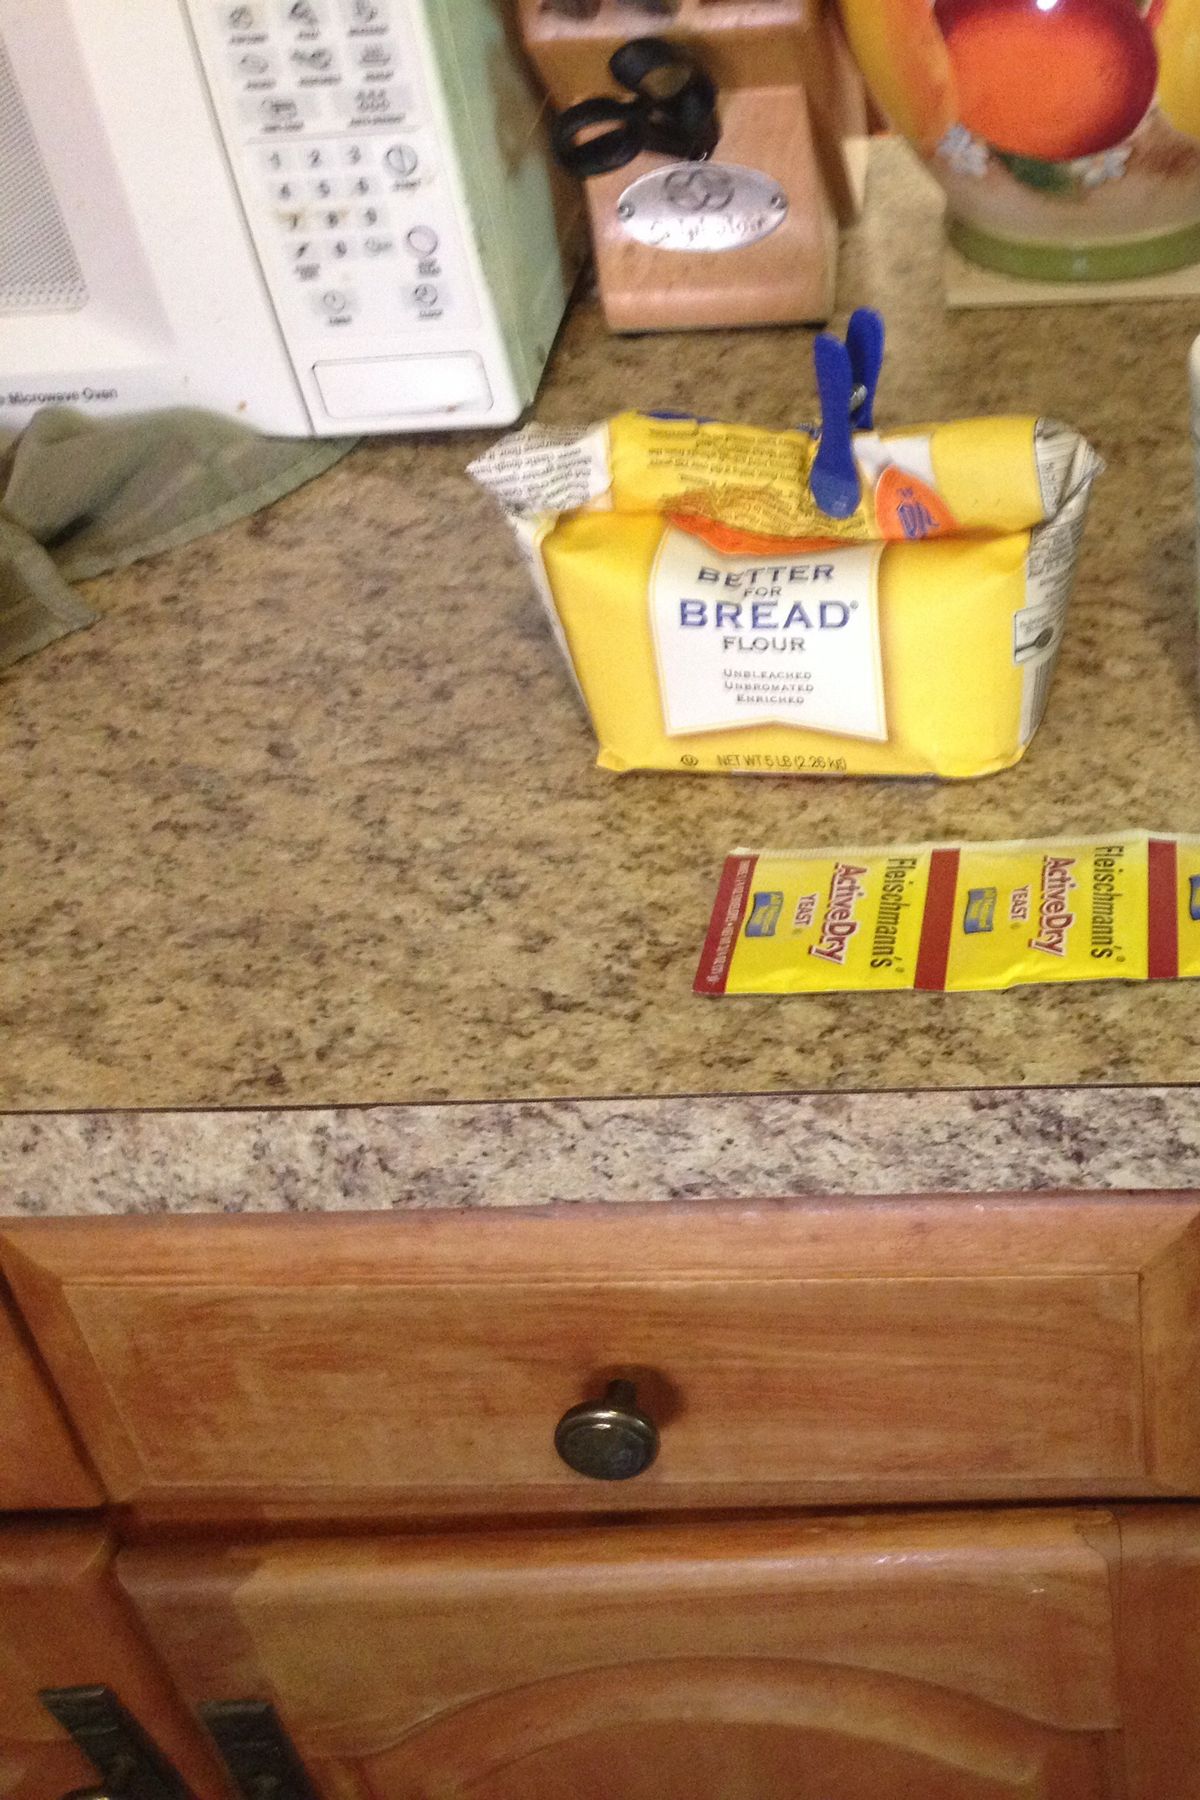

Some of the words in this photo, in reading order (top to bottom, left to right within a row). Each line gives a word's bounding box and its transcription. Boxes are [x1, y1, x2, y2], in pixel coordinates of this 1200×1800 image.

[8, 391, 80, 405] Microwave
[82, 386, 118, 400] Oven
[698, 563, 834, 588] BETTER
[743, 586, 782, 598] FOR
[723, 635, 806, 652] FLOUR
[717, 754, 740, 767] NET
[744, 755, 761, 767] WT
[765, 755, 775, 768] 5
[777, 756, 793, 768] LB
[792, 893, 819, 928] YEAST
[870, 858, 917, 970] Fleischmann's
[1010, 885, 1031, 921] YEAST
[1090, 845, 1124, 959] Fleischmann's
